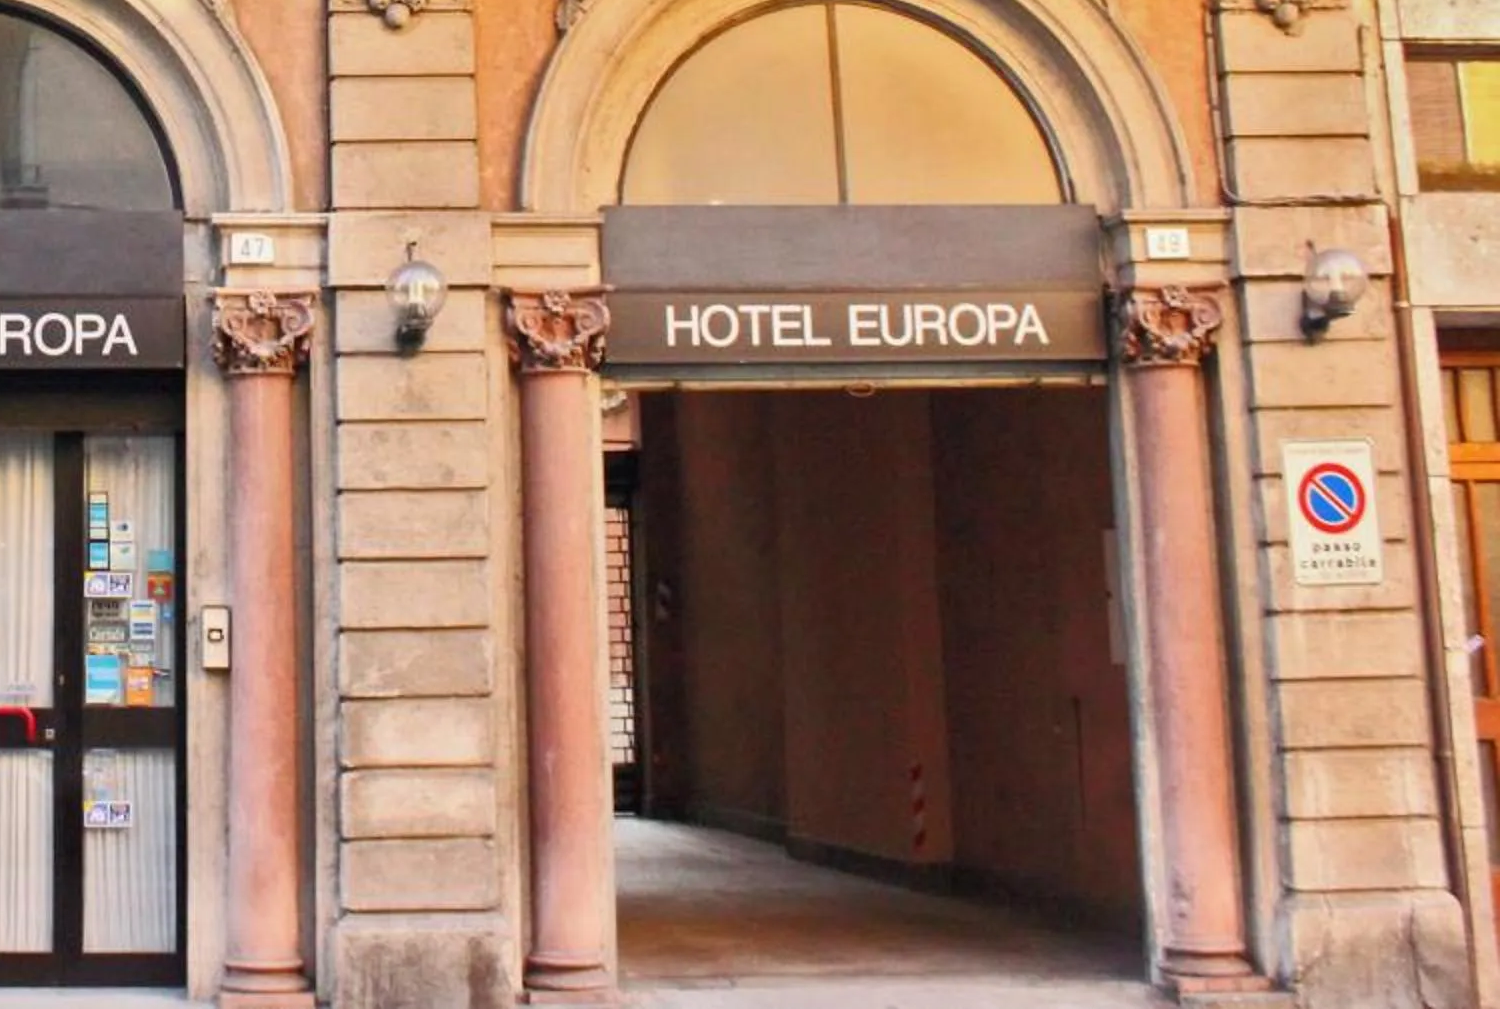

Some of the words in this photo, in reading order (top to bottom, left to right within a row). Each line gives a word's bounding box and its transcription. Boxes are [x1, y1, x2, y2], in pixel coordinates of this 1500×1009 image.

[240, 237, 264, 258] 47
[665, 304, 832, 347] HOTEL
[848, 303, 1050, 346] EUROPA
[1312, 542, 1361, 553] passo
[1300, 556, 1377, 569] carrabile
